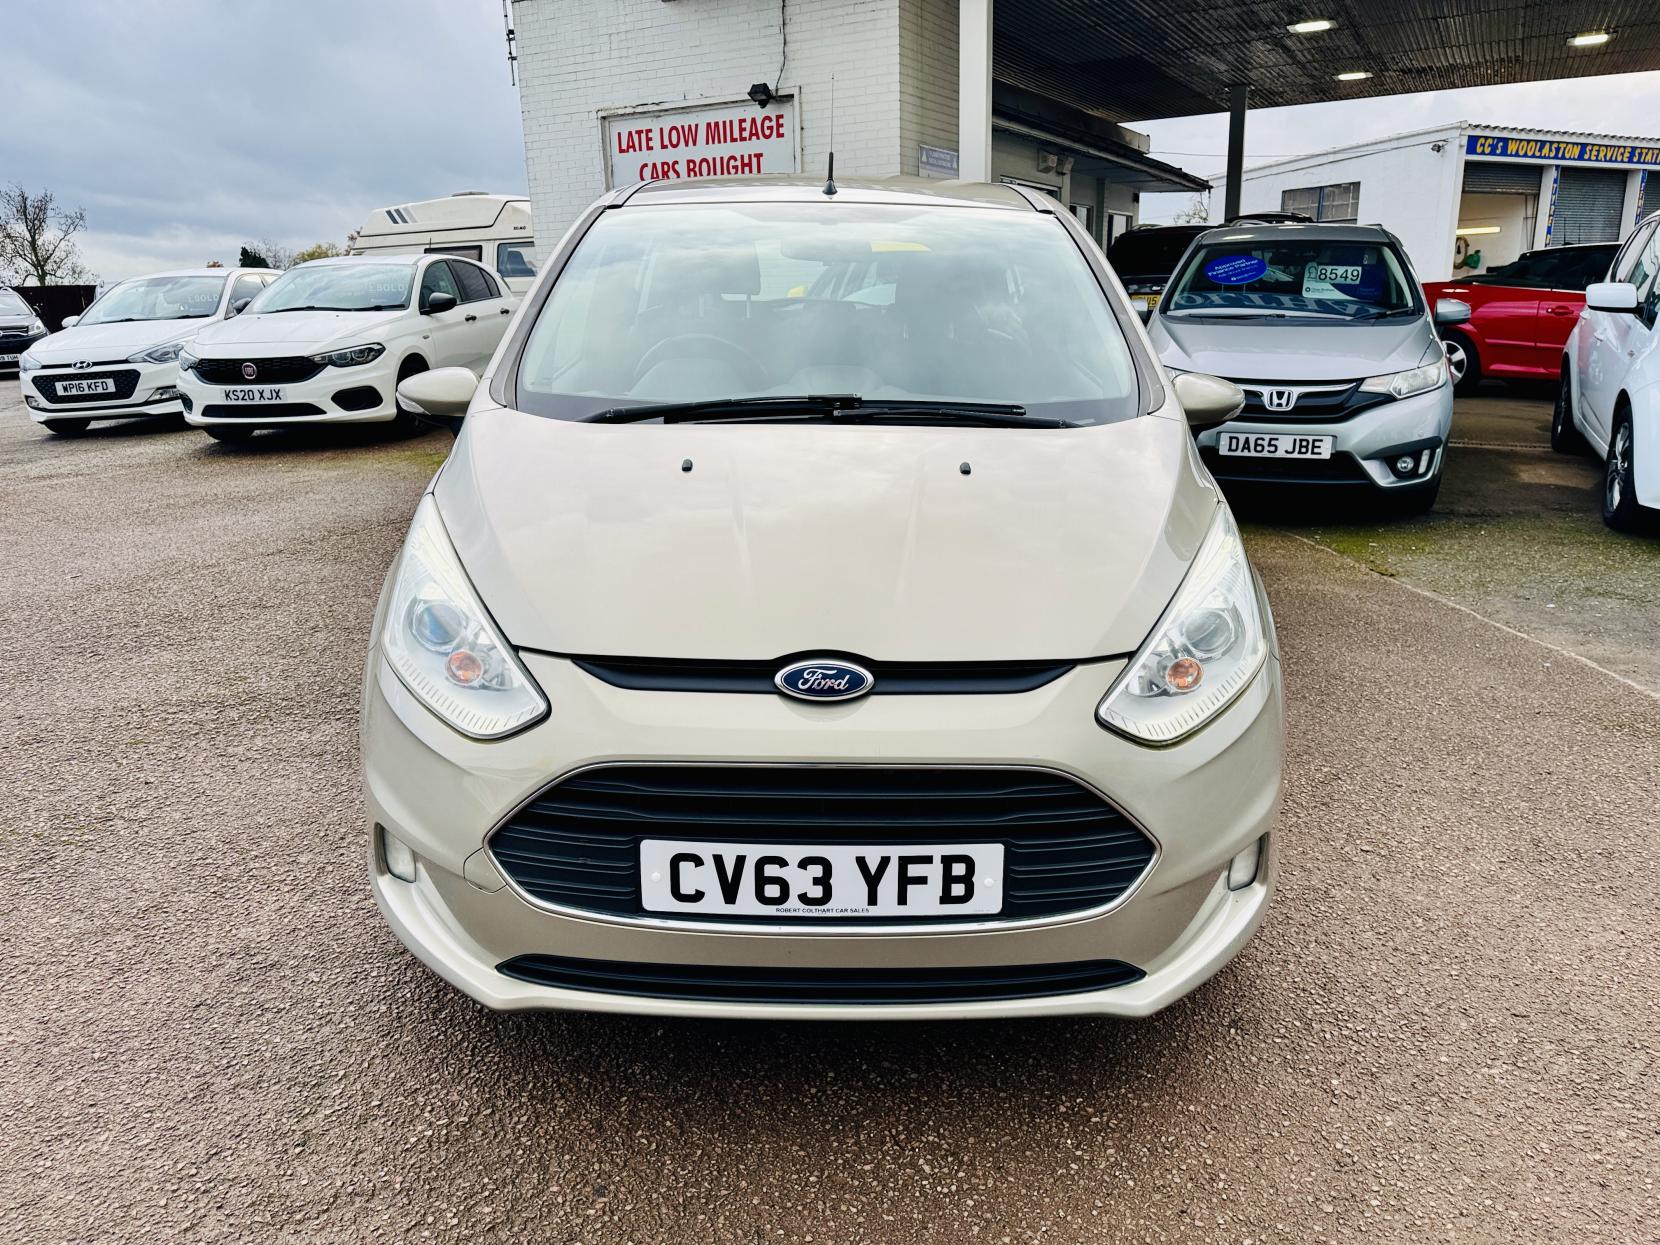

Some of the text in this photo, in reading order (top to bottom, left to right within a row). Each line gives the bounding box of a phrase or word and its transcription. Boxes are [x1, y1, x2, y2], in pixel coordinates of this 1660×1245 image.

[617, 114, 784, 154] LATE LOW MILEAGE
[1507, 139, 1581, 159] WOOLASTON
[1584, 144, 1631, 162] SERVICE
[639, 153, 764, 181] CARS BOUGHT
[62, 381, 108, 394] WP16 KFD
[225, 389, 282, 401] KS20 XJX
[1227, 436, 1324, 456] DA65 JBE
[802, 669, 850, 691] Ford
[669, 853, 976, 907] CV63 YFB
